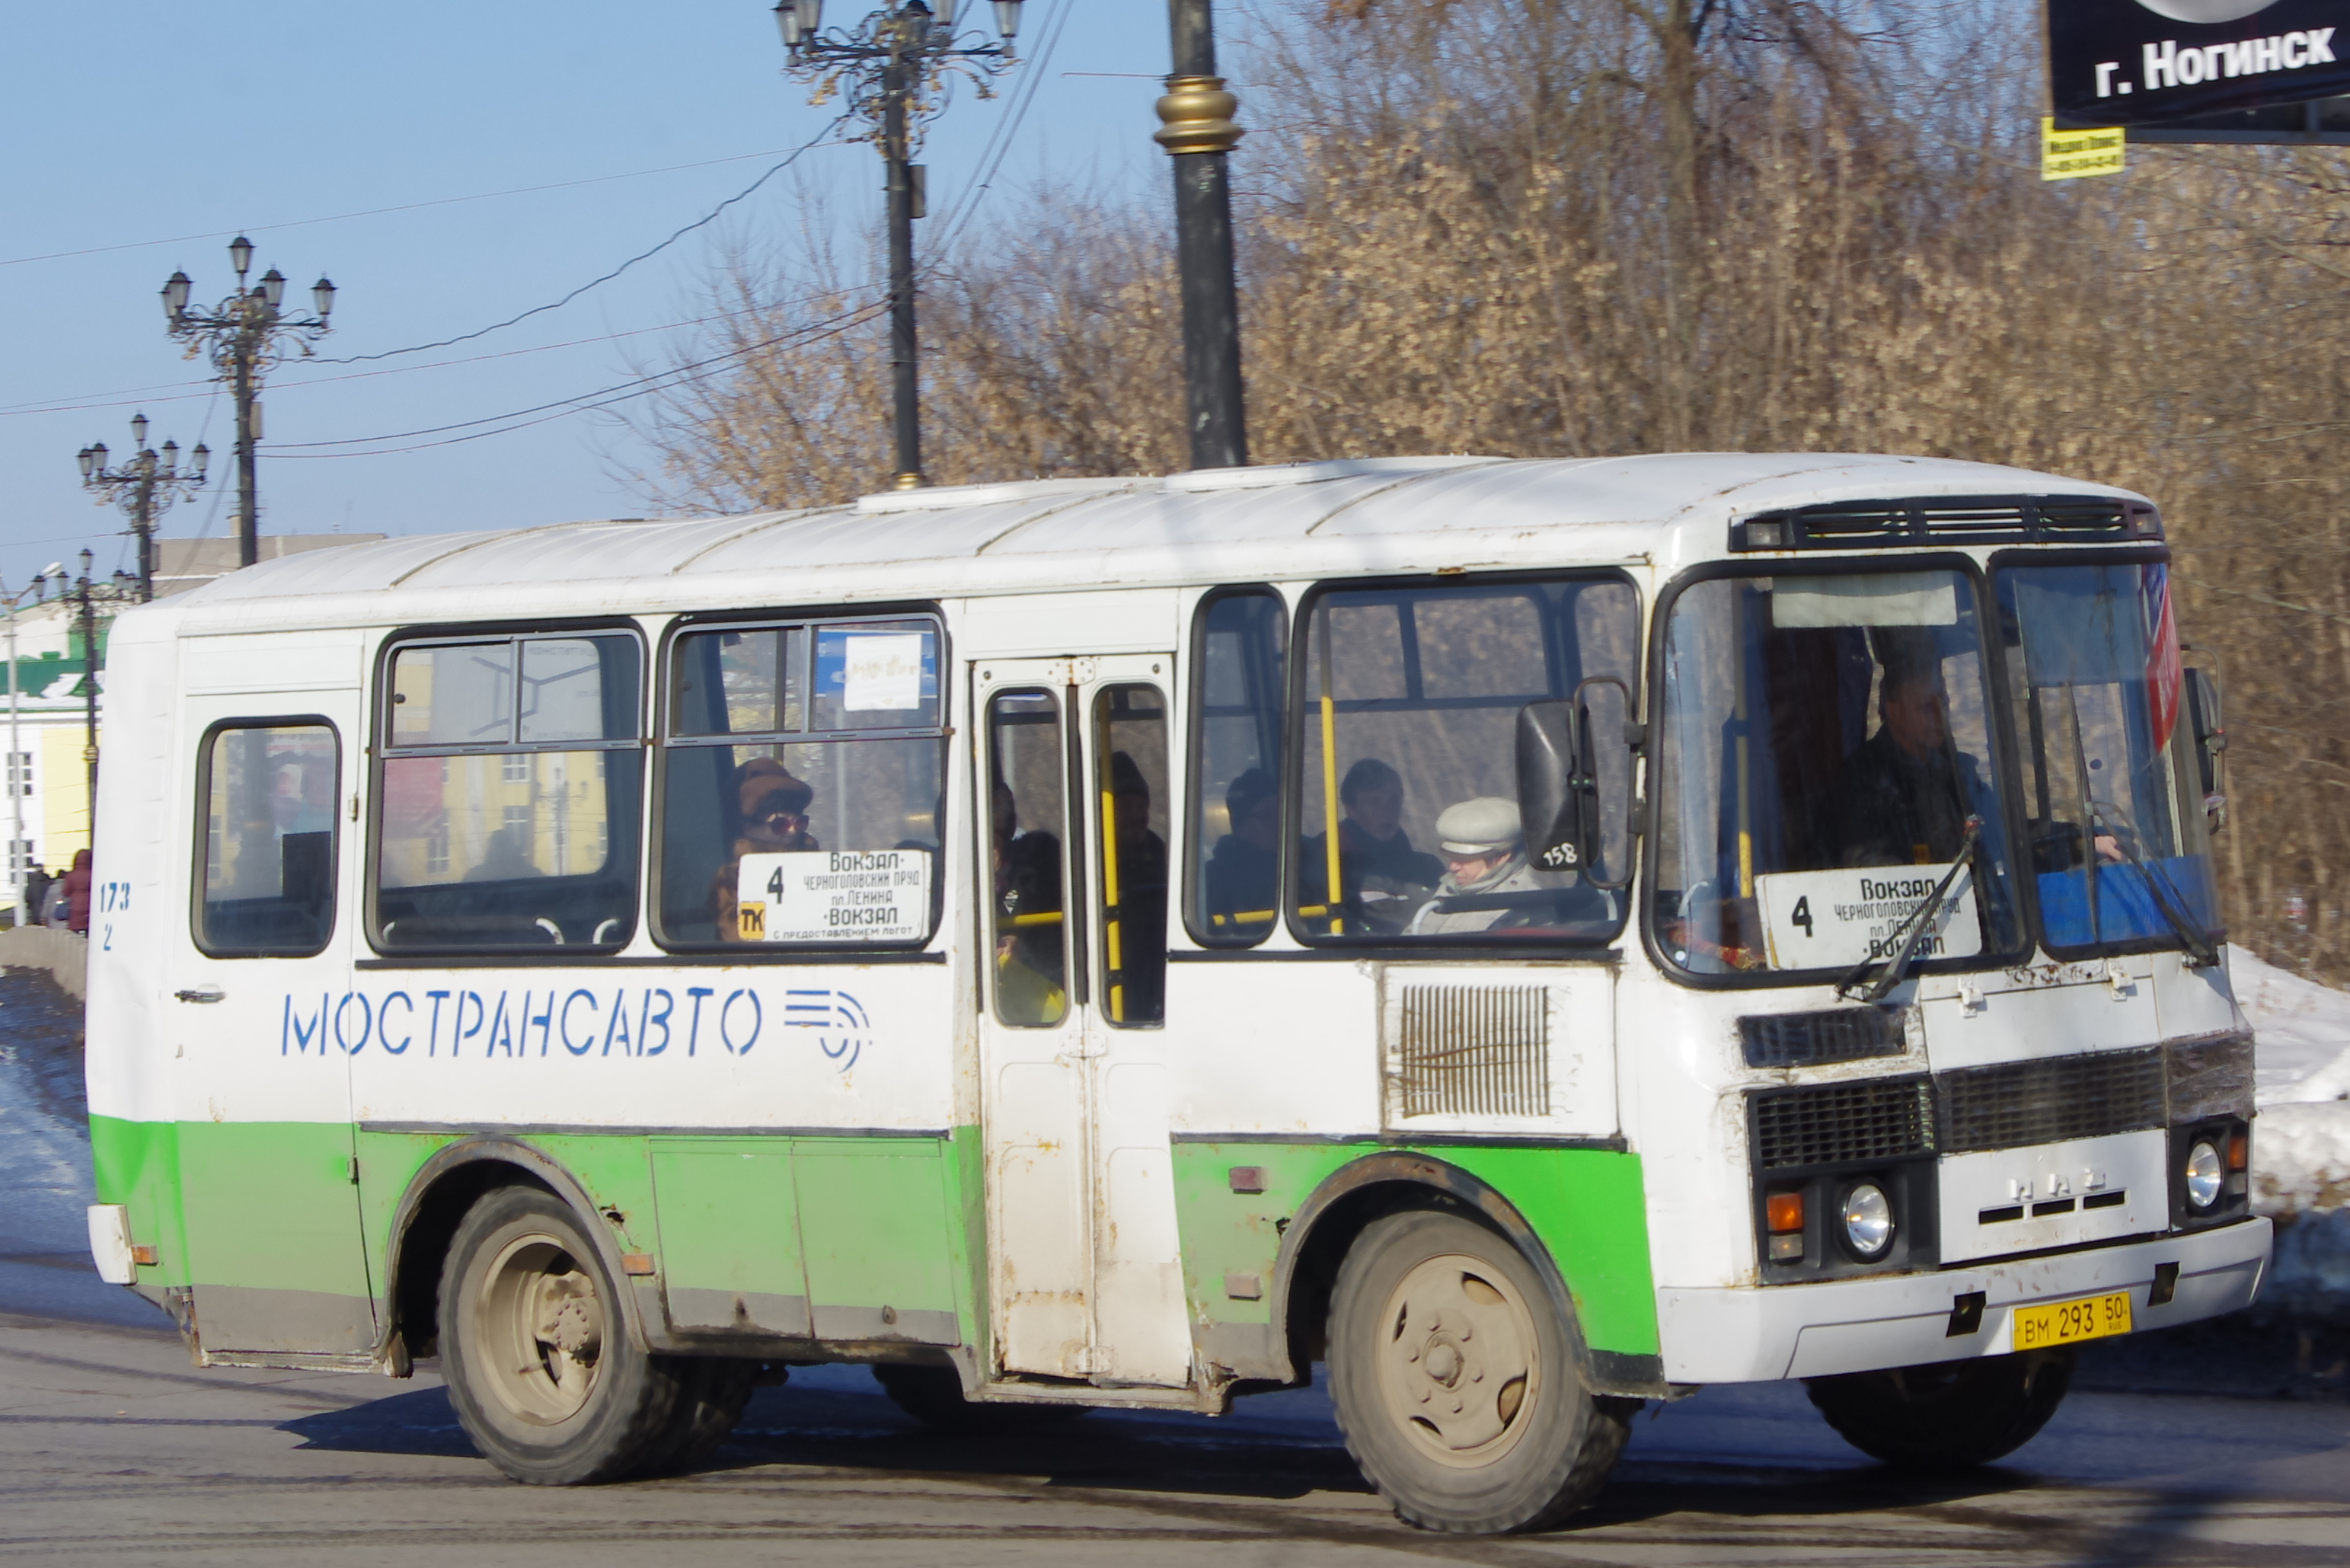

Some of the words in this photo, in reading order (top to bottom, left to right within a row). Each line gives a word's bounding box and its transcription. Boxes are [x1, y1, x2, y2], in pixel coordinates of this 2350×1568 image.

[2095, 62, 2132, 98] г.
[2142, 27, 2336, 90] Ногинск
[1543, 842, 1578, 867] 158
[767, 865, 784, 905] 4
[803, 872, 889, 890] ЧЕРНОГОЛОВСКИЙ
[894, 870, 920, 886] ПРУД
[101, 882, 130, 913] 173
[1834, 899, 1933, 922] ЧЕРНОГОЛОВСКИ
[740, 909, 764, 932] ТК
[1791, 895, 1813, 938] 4
[104, 923, 112, 951] 2
[774, 930, 780, 940] С
[783, 928, 880, 940] ПРЕДОСТАВЛЕНИЕМ
[883, 926, 913, 935] ЛЬГОТ
[282, 988, 762, 1058] МОСТРАНСАВТО
[2058, 1303, 2094, 1338] 293
[2105, 1296, 2123, 1320] 50
[2109, 1321, 2122, 1330] RUS
